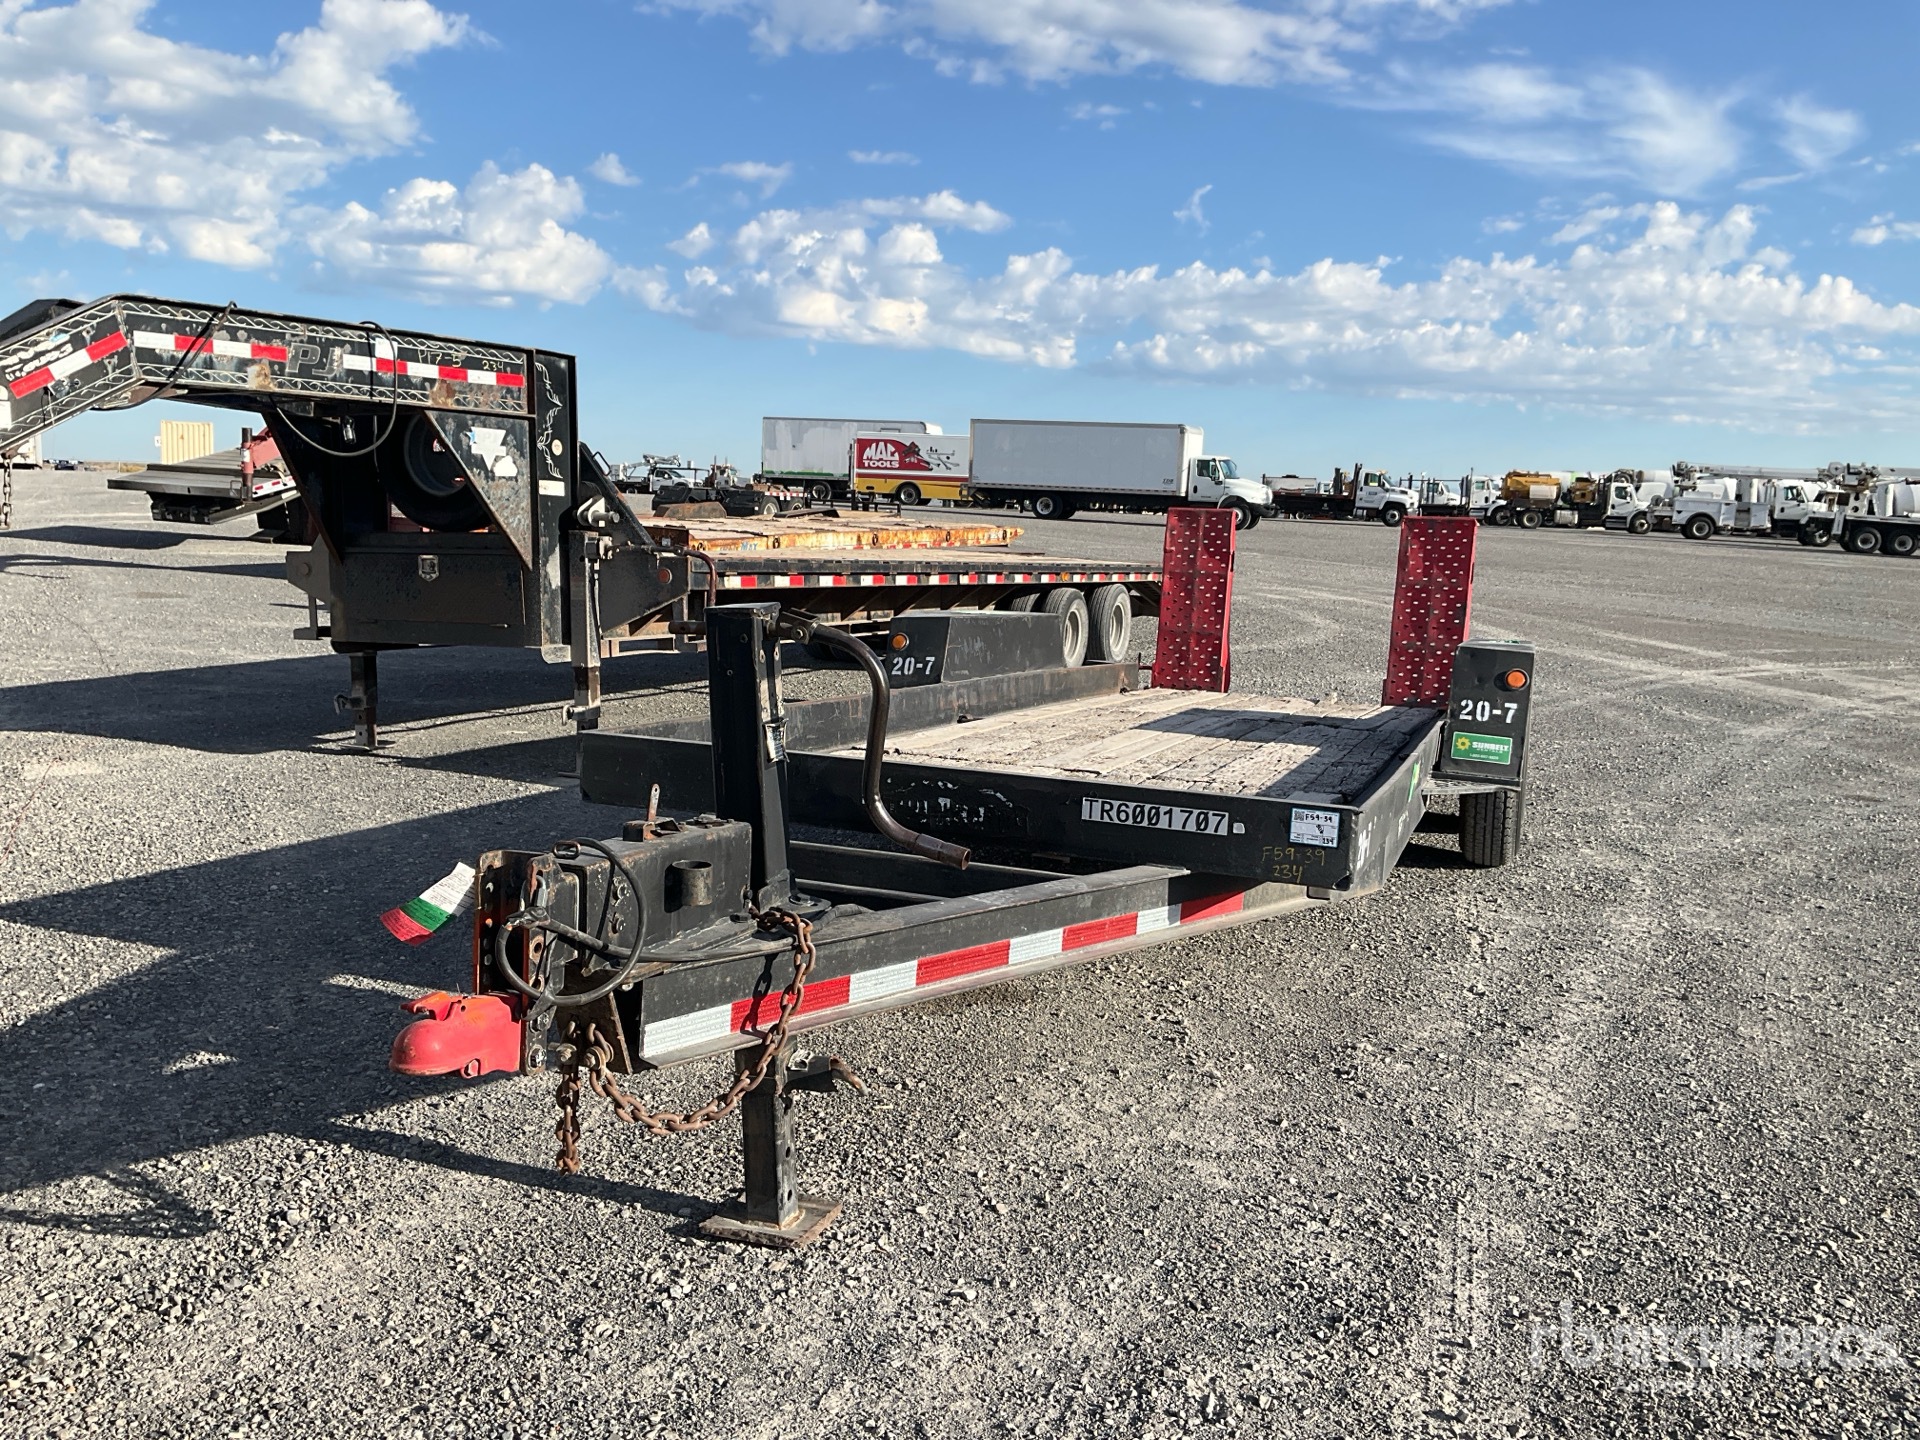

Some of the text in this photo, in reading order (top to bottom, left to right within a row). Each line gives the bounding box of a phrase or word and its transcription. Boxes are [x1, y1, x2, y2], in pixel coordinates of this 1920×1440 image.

[863, 441, 899, 460] MAC
[863, 460, 899, 468] TOOLS
[891, 656, 936, 676] 20-7
[1459, 699, 1518, 724] 20-7
[1084, 799, 1227, 834] TR6001707
[1305, 813, 1333, 823] F59-39
[1262, 846, 1325, 867] F59-39
[1272, 864, 1303, 884] 234
